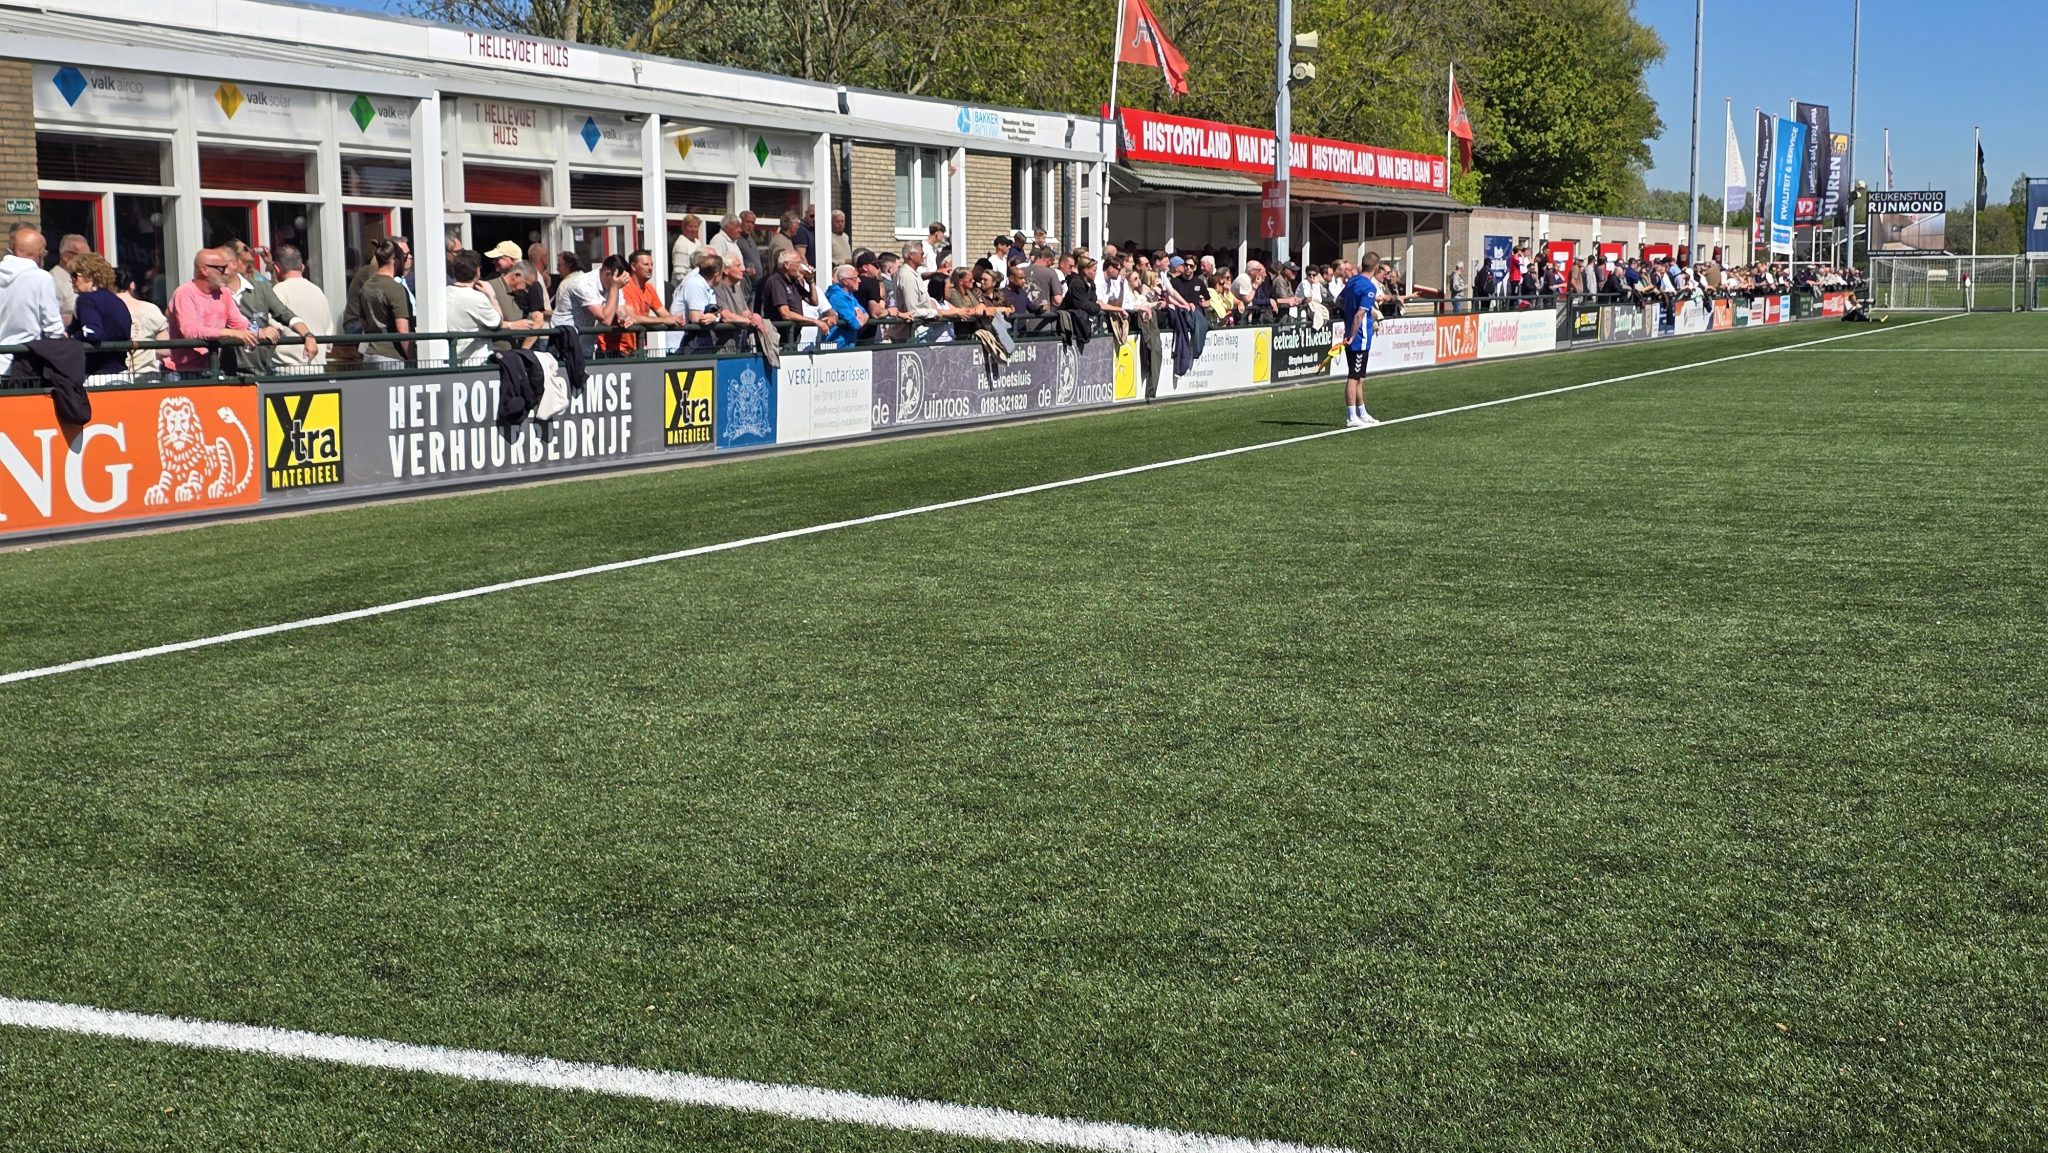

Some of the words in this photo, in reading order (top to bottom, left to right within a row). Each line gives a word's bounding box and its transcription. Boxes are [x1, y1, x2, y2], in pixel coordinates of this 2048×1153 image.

[479, 34, 538, 64] HELLEVOET
[542, 46, 568, 68] HUIS
[91, 75, 115, 90] valk
[116, 78, 144, 94] airco
[246, 92, 268, 106] valk
[269, 94, 291, 109] solar
[378, 105, 396, 119] valk
[485, 105, 536, 128] HELLEVOET
[974, 111, 998, 125] BAKKER
[492, 125, 518, 146] HUIS
[1143, 120, 1232, 160] HISTORYLAND
[1236, 134, 1258, 164] VAN
[1260, 138, 1276, 166] DE
[1289, 140, 1308, 169] BAN
[1810, 125, 1818, 144] Total
[1809, 144, 1818, 160] Tyre
[1312, 144, 1375, 177] HISTORYLAND
[1377, 154, 1394, 180] VAN
[1395, 158, 1412, 182] DEN
[1414, 160, 1430, 184] BAN
[1759, 160, 1767, 177] Tyre
[1780, 173, 1792, 222] KWALITEIT
[1786, 126, 1799, 165] SERVICE
[1824, 156, 1841, 216] HUREN
[1868, 192, 1944, 202] KEUKENSTUDIO
[1868, 201, 1944, 214] RIJNMOND
[1306, 326, 1332, 347] Hoeckie
[1404, 322, 1409, 334] de
[1488, 320, 1519, 348] Lindeloof
[1214, 334, 1224, 347] Den
[1225, 334, 1238, 348] Haag
[1438, 324, 1461, 358] ING
[1027, 345, 1036, 362] 94
[787, 368, 824, 388] VERZIJL
[825, 364, 870, 383] notarissen
[978, 370, 1032, 390] Helevoetsluis
[872, 398, 890, 425] de
[896, 351, 970, 423] Duinroos
[1038, 384, 1052, 408] de
[389, 383, 441, 430] HET
[453, 372, 632, 424] ROTAMSE
[665, 370, 711, 430] Xtra
[980, 394, 1028, 414] 0181-321820
[268, 394, 338, 469] Xtra
[668, 427, 710, 445] MATERIEEL
[389, 414, 632, 478] VERHUURBEDRIJF
[0, 421, 134, 522] NG
[272, 464, 338, 489] MATERIEEL
